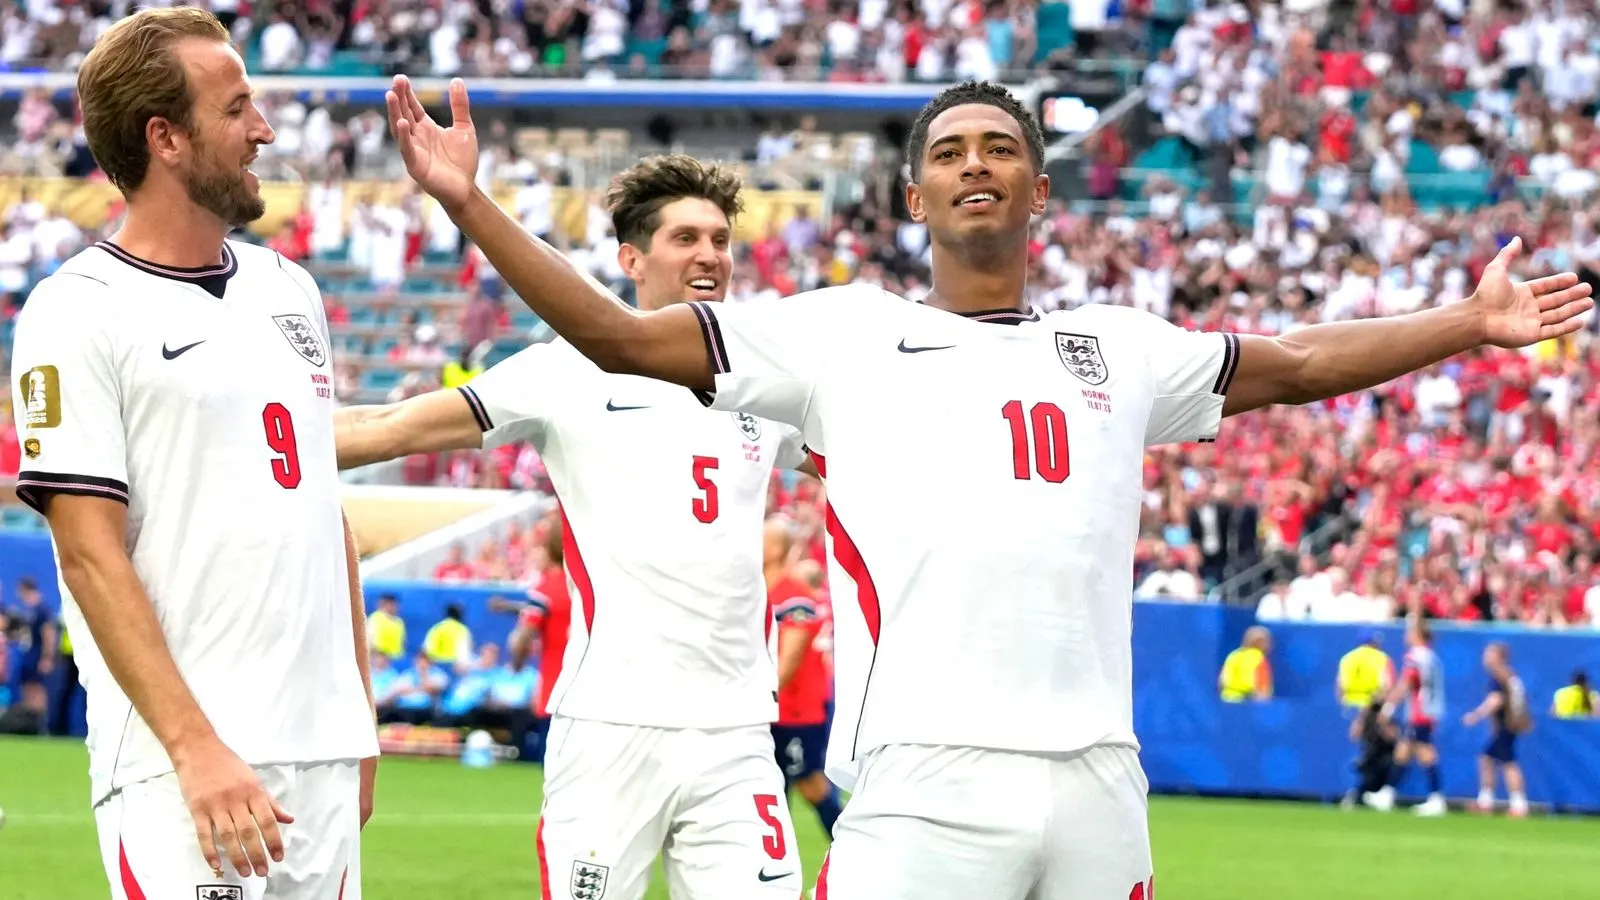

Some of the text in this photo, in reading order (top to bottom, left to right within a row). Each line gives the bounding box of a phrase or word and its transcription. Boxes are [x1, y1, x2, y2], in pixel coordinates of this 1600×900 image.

[1081, 389, 1111, 402] NORWAY
[262, 402, 302, 489] 9
[1002, 400, 1070, 483] 10
[692, 455, 719, 524] 5
[753, 794, 786, 860] 5
